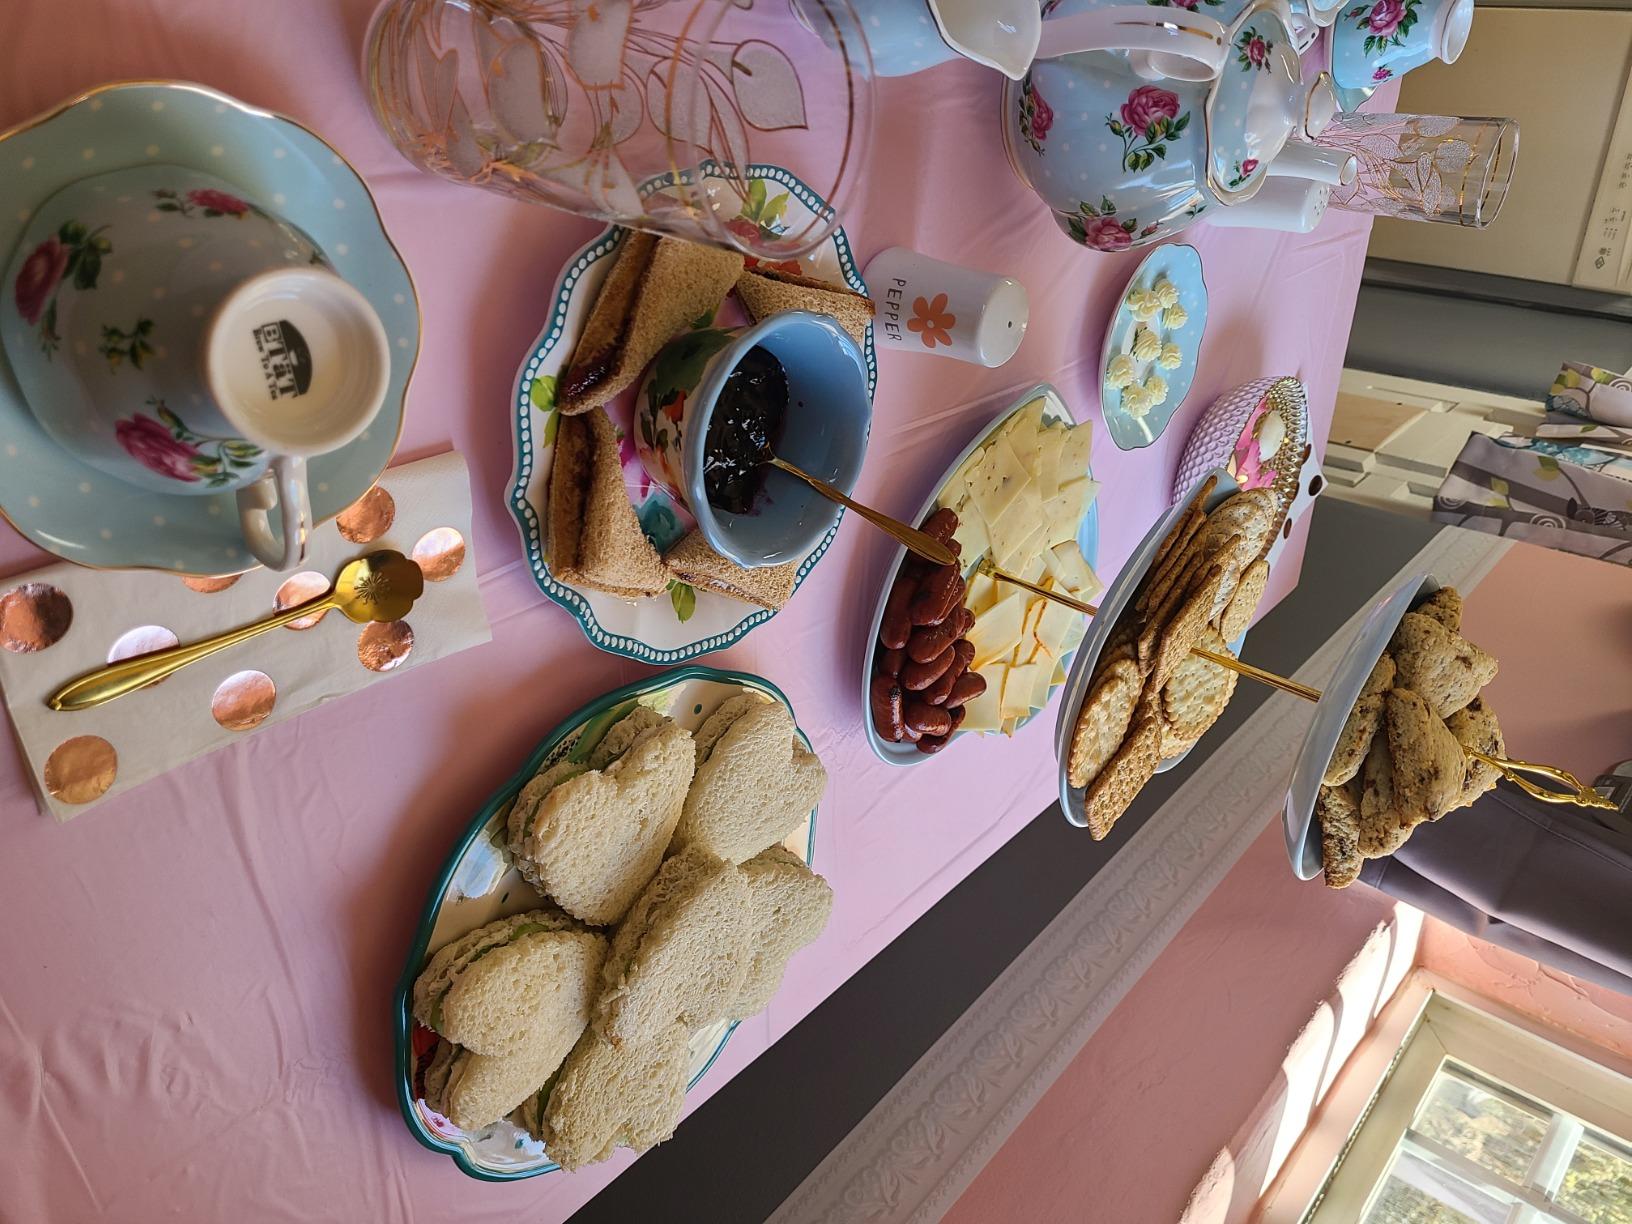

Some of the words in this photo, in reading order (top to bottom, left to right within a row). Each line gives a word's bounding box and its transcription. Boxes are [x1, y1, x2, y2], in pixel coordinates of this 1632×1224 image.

[884, 278, 907, 341] PEPPER
[253, 328, 264, 352] Brew
[261, 354, 270, 370] To
[265, 372, 274, 380] A
[268, 381, 278, 400] Tea
